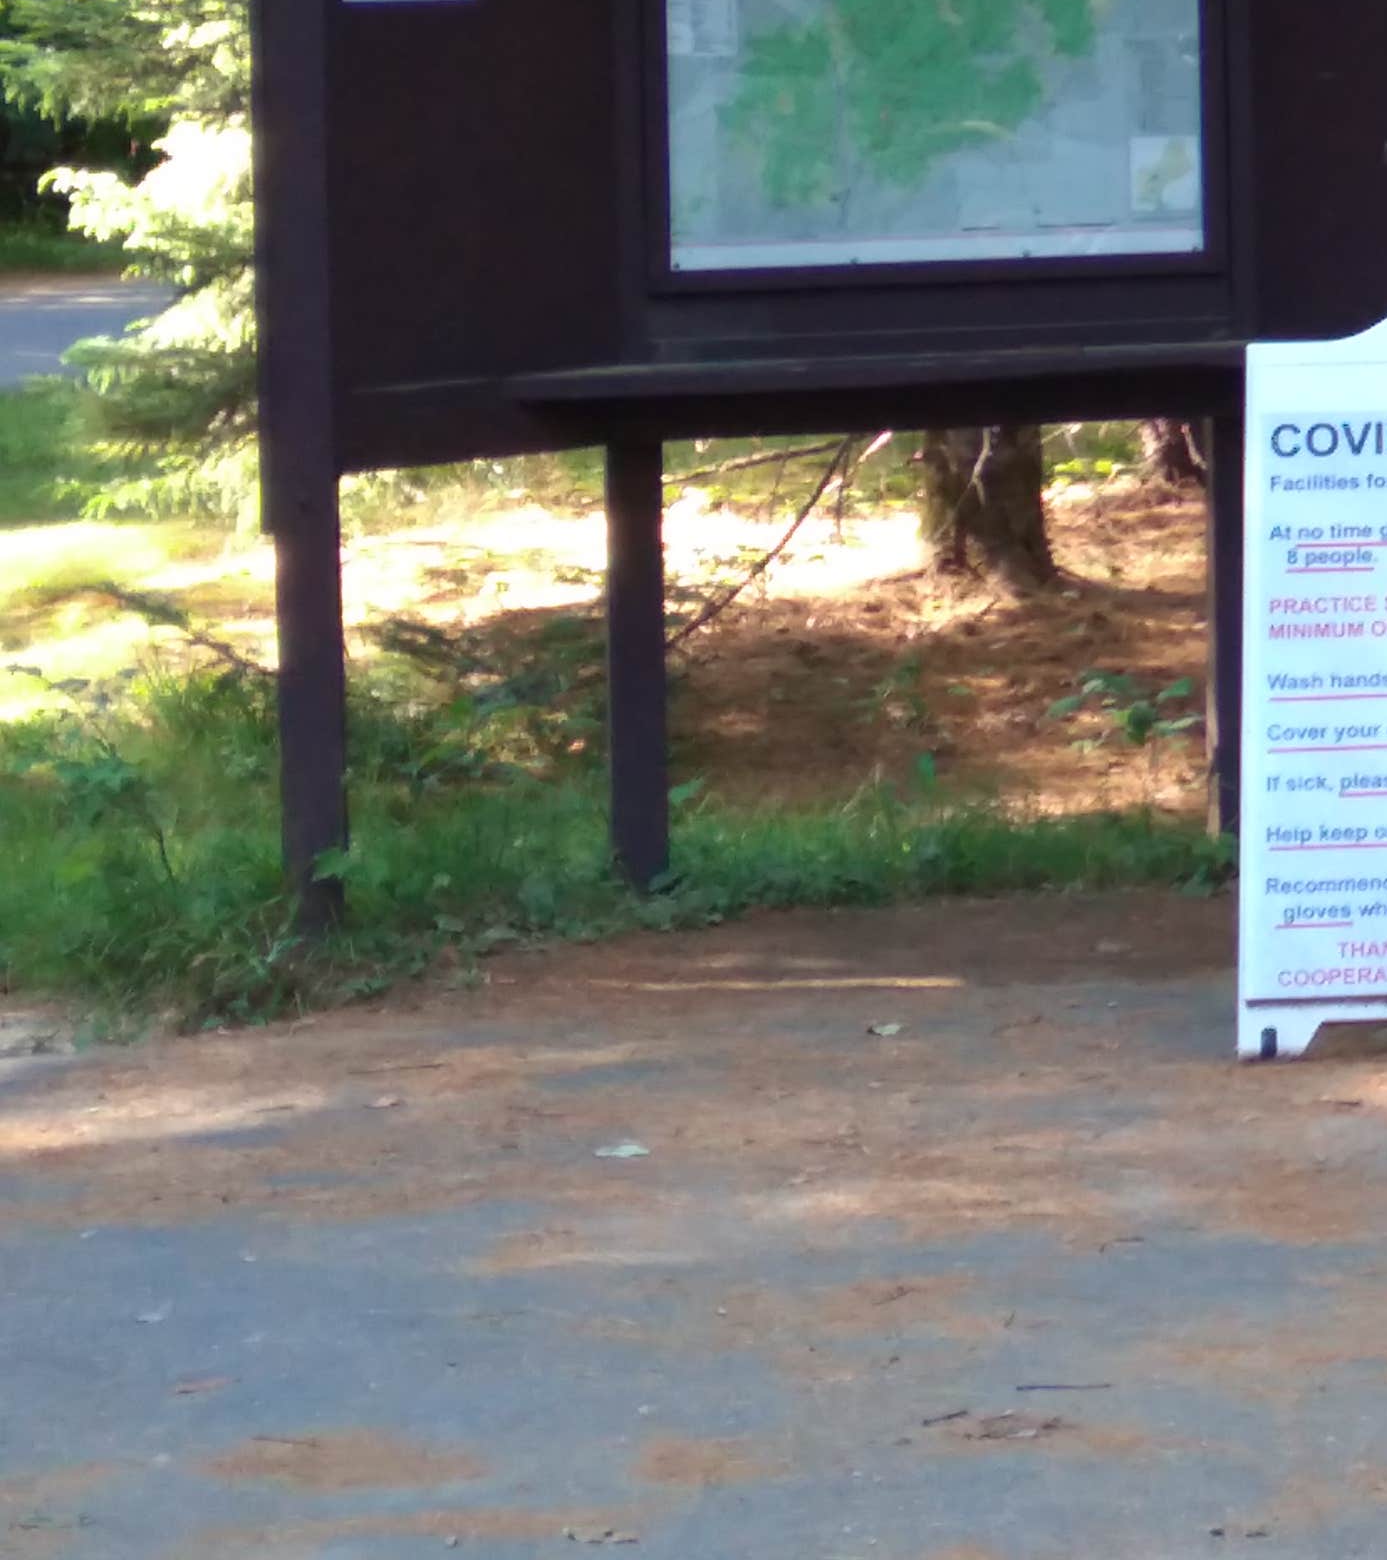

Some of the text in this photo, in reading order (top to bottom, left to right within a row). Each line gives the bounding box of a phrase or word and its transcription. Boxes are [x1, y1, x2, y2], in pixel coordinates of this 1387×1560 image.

[1270, 473, 1360, 492] Facilities
[1269, 525, 1291, 541] At
[1297, 527, 1324, 540] no
[1329, 523, 1372, 539] time
[1287, 549, 1297, 564] 8
[1269, 595, 1375, 614] PRACTICE
[1268, 620, 1363, 639] MINIMUM
[1267, 672, 1323, 690] Wash
[1266, 723, 1327, 741] Cover
[1333, 725, 1380, 743] your
[1266, 825, 1312, 847] Help
[1318, 824, 1368, 845] keep
[1283, 902, 1351, 923] gloves
